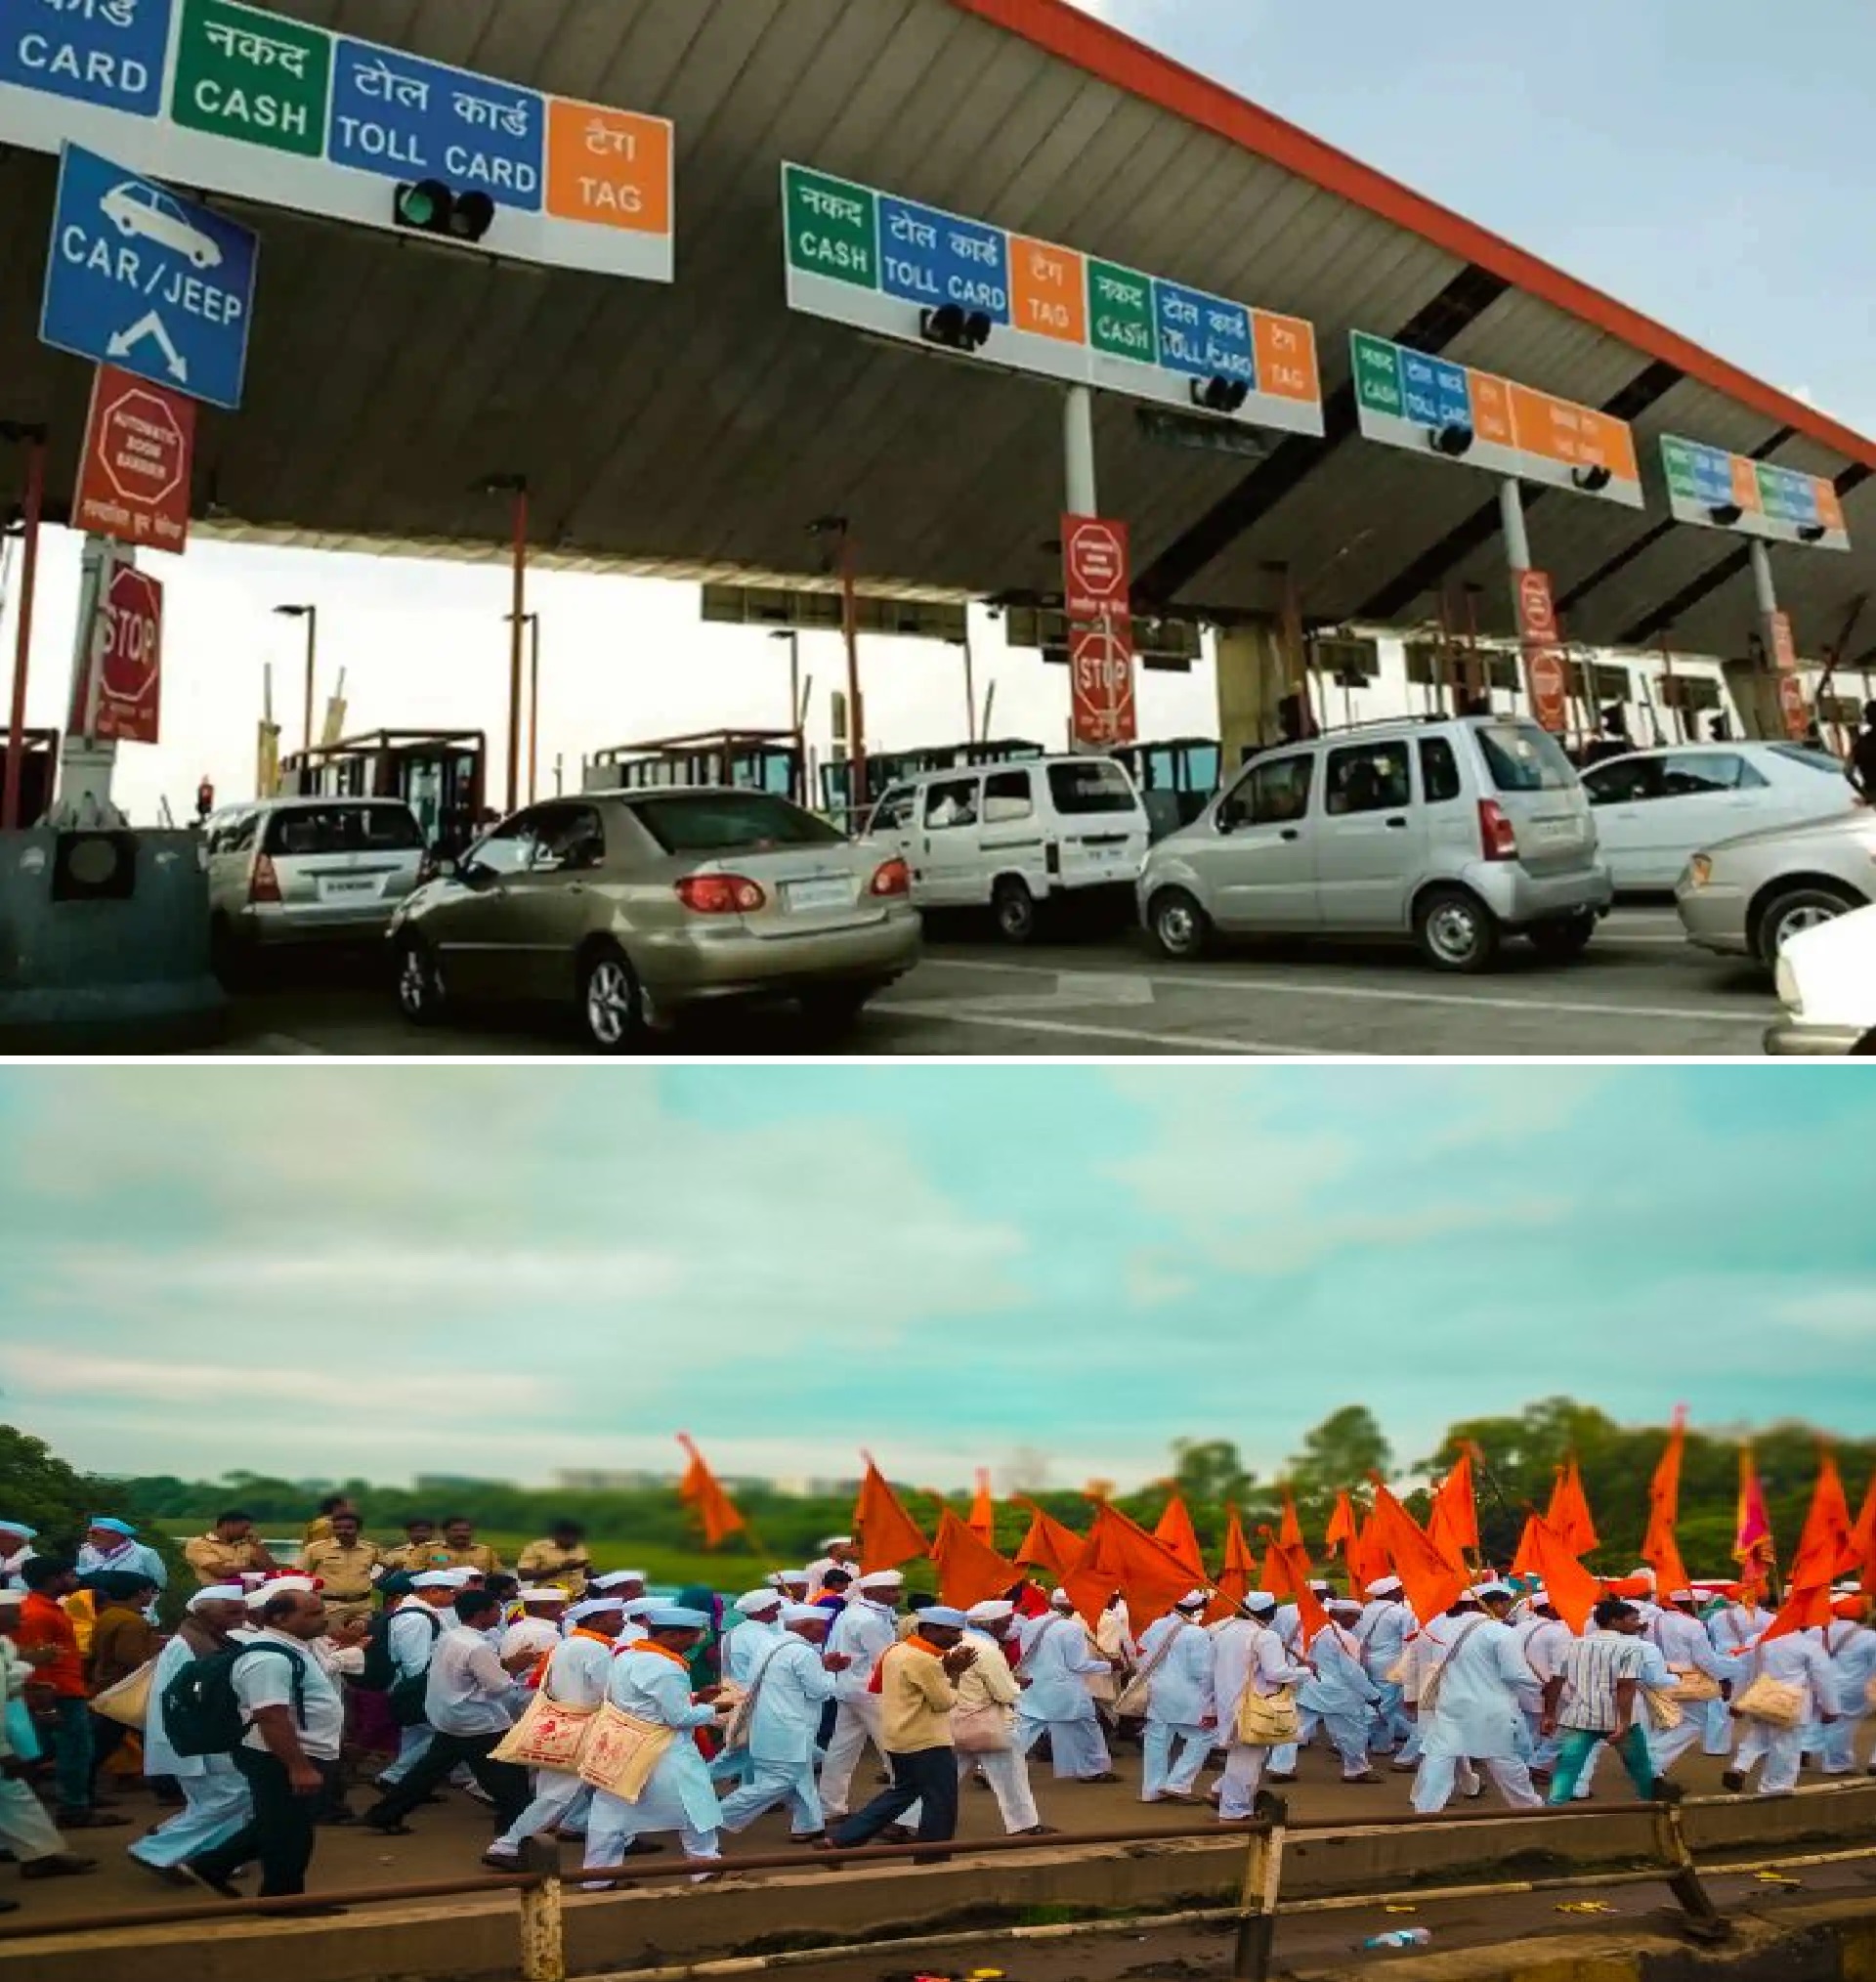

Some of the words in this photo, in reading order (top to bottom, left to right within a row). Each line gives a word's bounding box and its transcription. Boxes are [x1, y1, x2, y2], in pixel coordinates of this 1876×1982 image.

[19, 33, 148, 92] CARD
[203, 21, 310, 79] नकद
[194, 79, 307, 135] CASH
[353, 59, 430, 110] टोल
[452, 92, 530, 137] कार्ड
[338, 116, 427, 166] TOLL
[445, 146, 535, 193] CARD
[579, 176, 643, 213] TAG
[798, 185, 864, 228] नकद
[799, 232, 868, 273] CASH
[888, 210, 937, 249] टोल
[948, 232, 998, 267] कार्ड
[884, 256, 939, 293] TOLL
[947, 275, 1005, 311] CARD
[1029, 297, 1069, 328] TAG
[1096, 315, 1149, 350] CASH
[1162, 326, 1203, 366] TOLL
[1272, 364, 1304, 389] TAG
[102, 603, 155, 666] STOP
[1081, 657, 1127, 690] STOP
